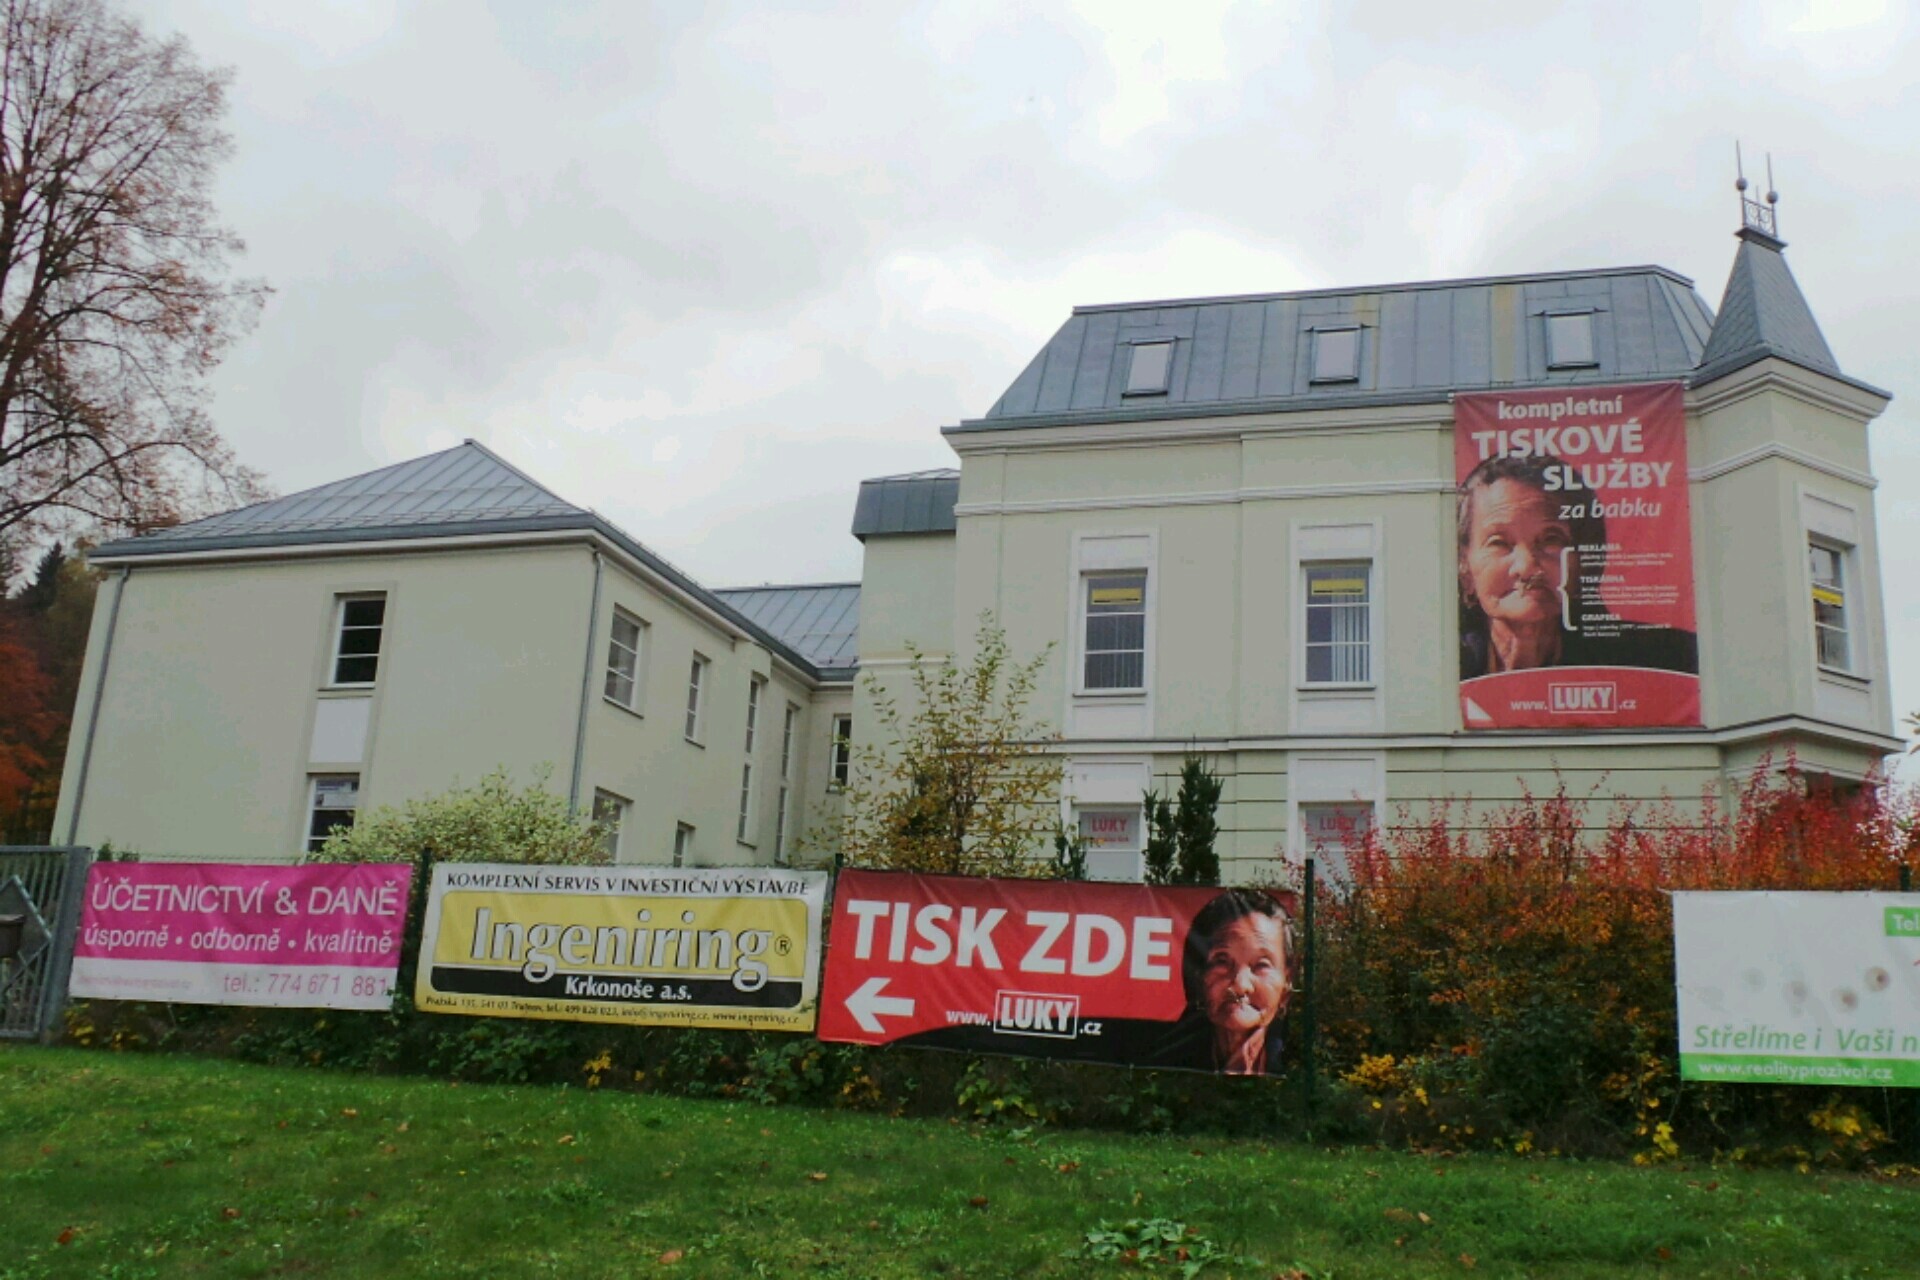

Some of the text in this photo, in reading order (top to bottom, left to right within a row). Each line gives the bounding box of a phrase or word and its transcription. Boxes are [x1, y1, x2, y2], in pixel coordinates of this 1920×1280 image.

[1499, 395, 1623, 421] kompletní
[1471, 418, 1645, 460] TISKOVÉ
[1542, 457, 1673, 491] SLUŽBY
[1558, 498, 1662, 520] za babku
[92, 877, 399, 916] ÚČETNICTVÍ & DANĚ
[446, 869, 809, 896] KOMPLEXNÍ SERVIS V INVESTIČNÍ VÝSTAVBĚ
[84, 925, 393, 954] úsporně odborně kvalitně
[847, 899, 1173, 981] TISK ZDE
[268, 973, 301, 994] 774
[307, 973, 340, 995] 671
[564, 975, 692, 1000] Krkonoše a.s.
[1693, 1024, 1807, 1050] Střelíme
[1814, 1028, 1822, 1050] i
[1836, 1028, 1895, 1052] Vaši
